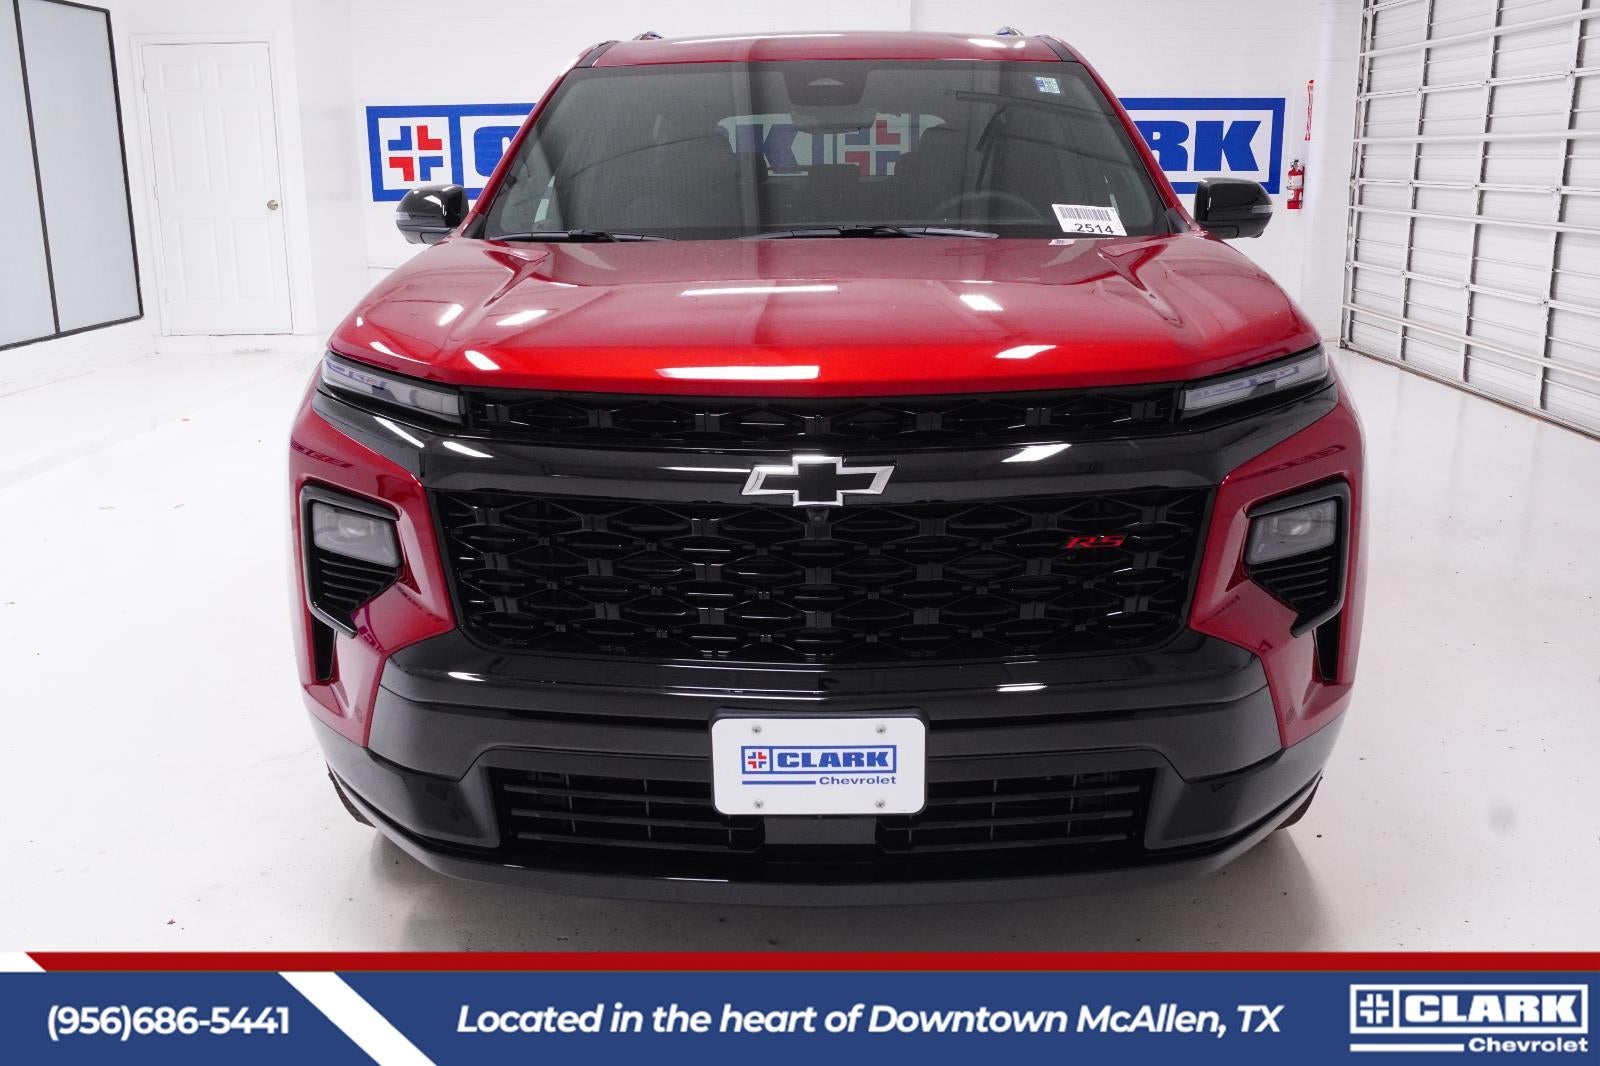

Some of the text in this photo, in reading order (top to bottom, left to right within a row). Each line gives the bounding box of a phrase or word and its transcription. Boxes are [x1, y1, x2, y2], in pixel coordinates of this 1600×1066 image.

[1074, 223, 1115, 234] 2514
[1065, 535, 1125, 549] RS
[777, 751, 889, 768] CLARK
[819, 776, 897, 785] Chevrolet
